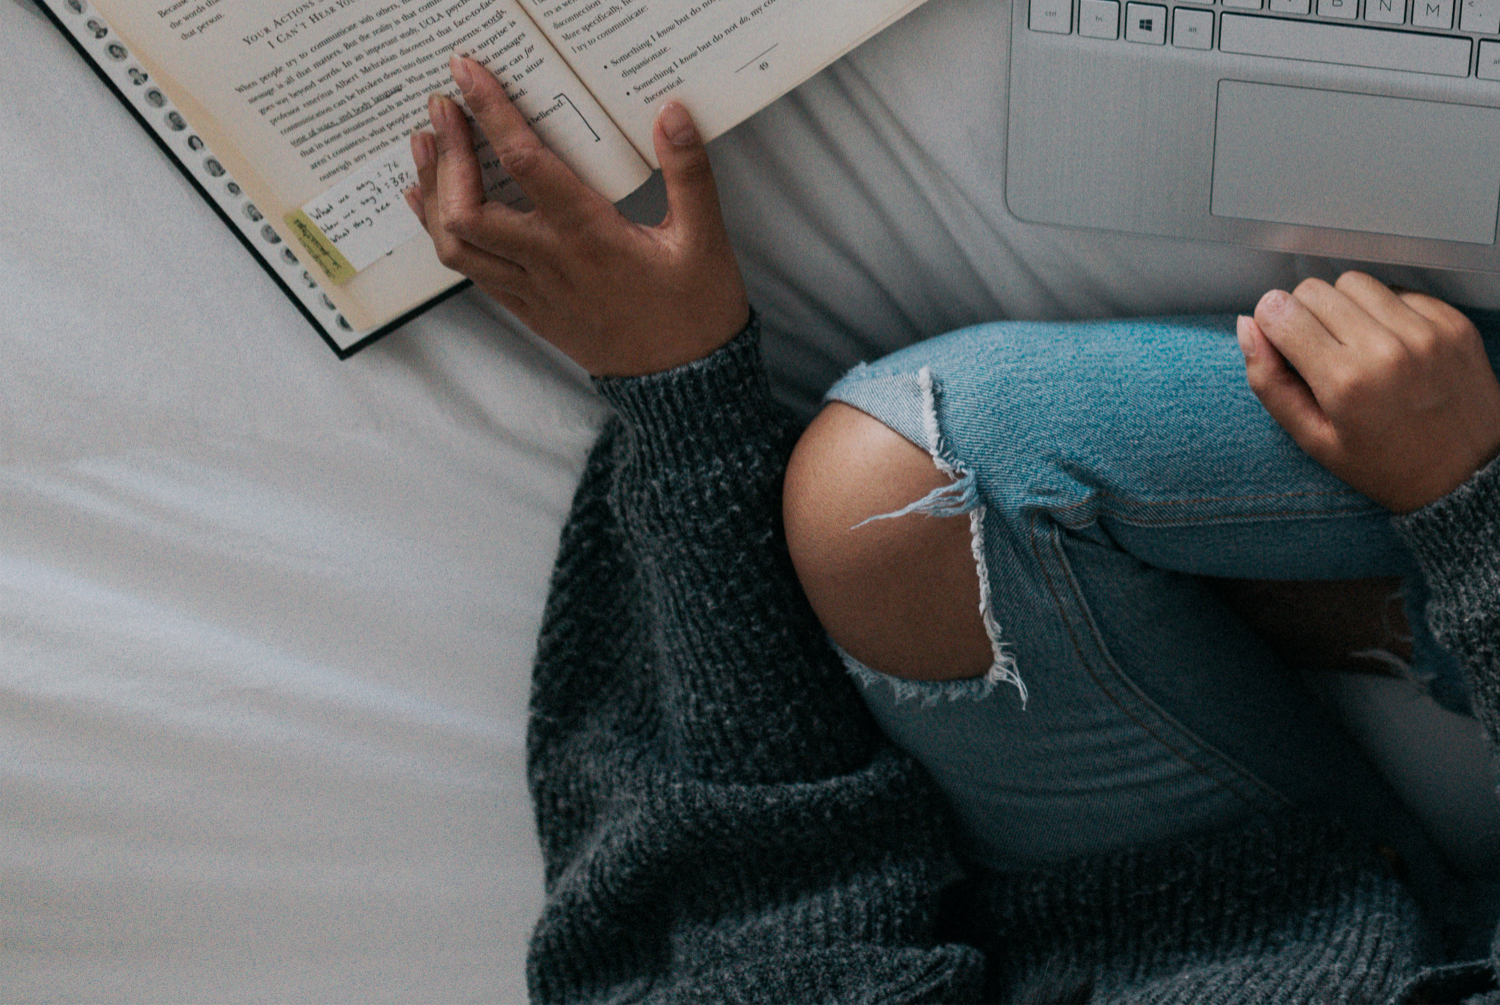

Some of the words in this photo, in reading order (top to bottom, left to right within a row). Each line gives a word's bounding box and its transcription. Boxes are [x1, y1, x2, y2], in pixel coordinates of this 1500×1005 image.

[1426, 3, 1440, 17] M
[267, 41, 275, 49] I
[759, 62, 769, 71] 49
[310, 204, 333, 220] What
[330, 228, 350, 243] What
